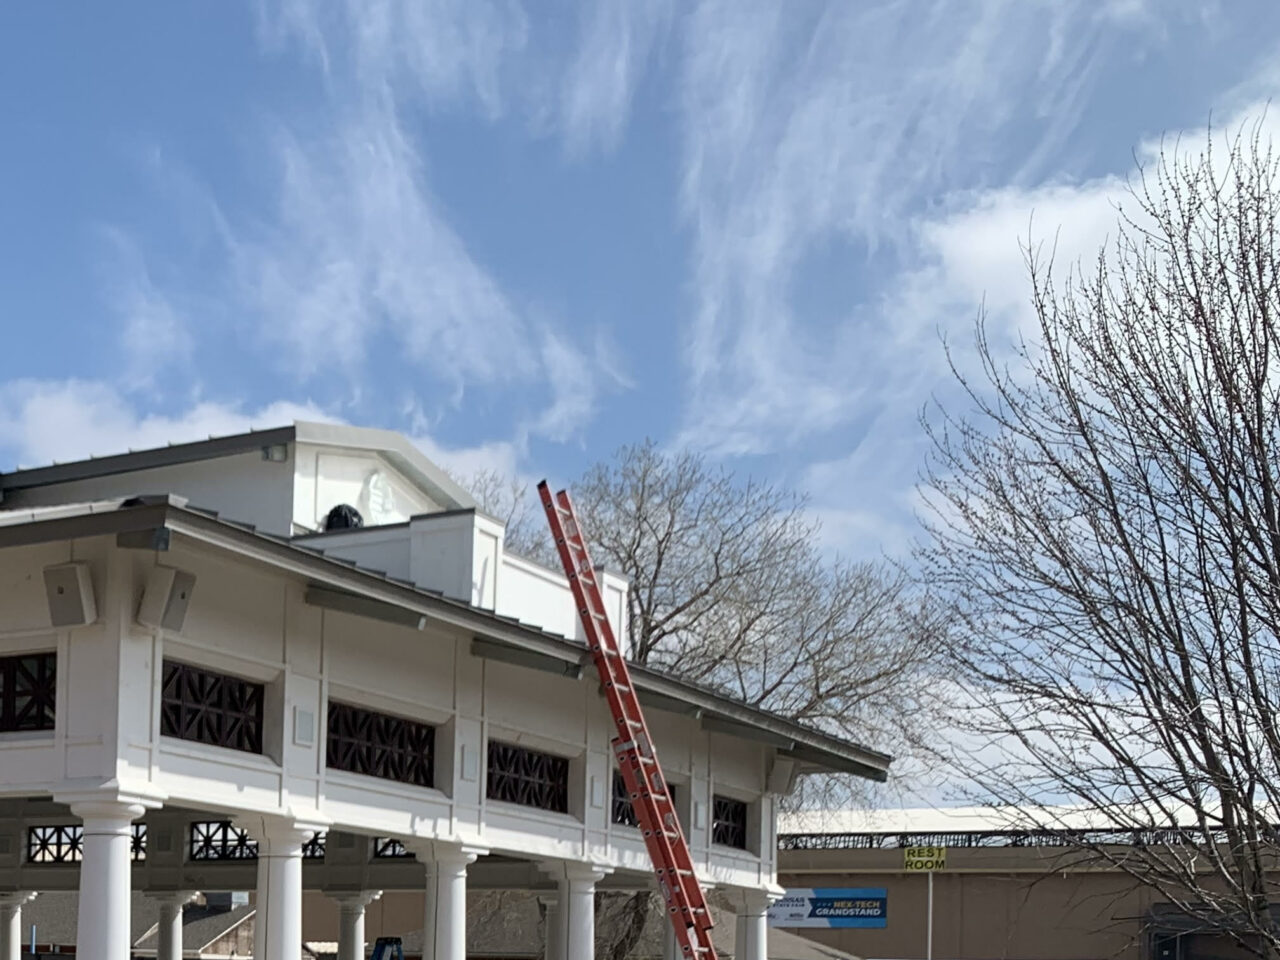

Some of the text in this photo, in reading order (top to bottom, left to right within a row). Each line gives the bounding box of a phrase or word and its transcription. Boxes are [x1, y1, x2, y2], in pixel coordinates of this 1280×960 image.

[906, 848, 943, 858] REST
[905, 860, 945, 870] ROOM
[815, 908, 881, 916] GRANDSTAND
